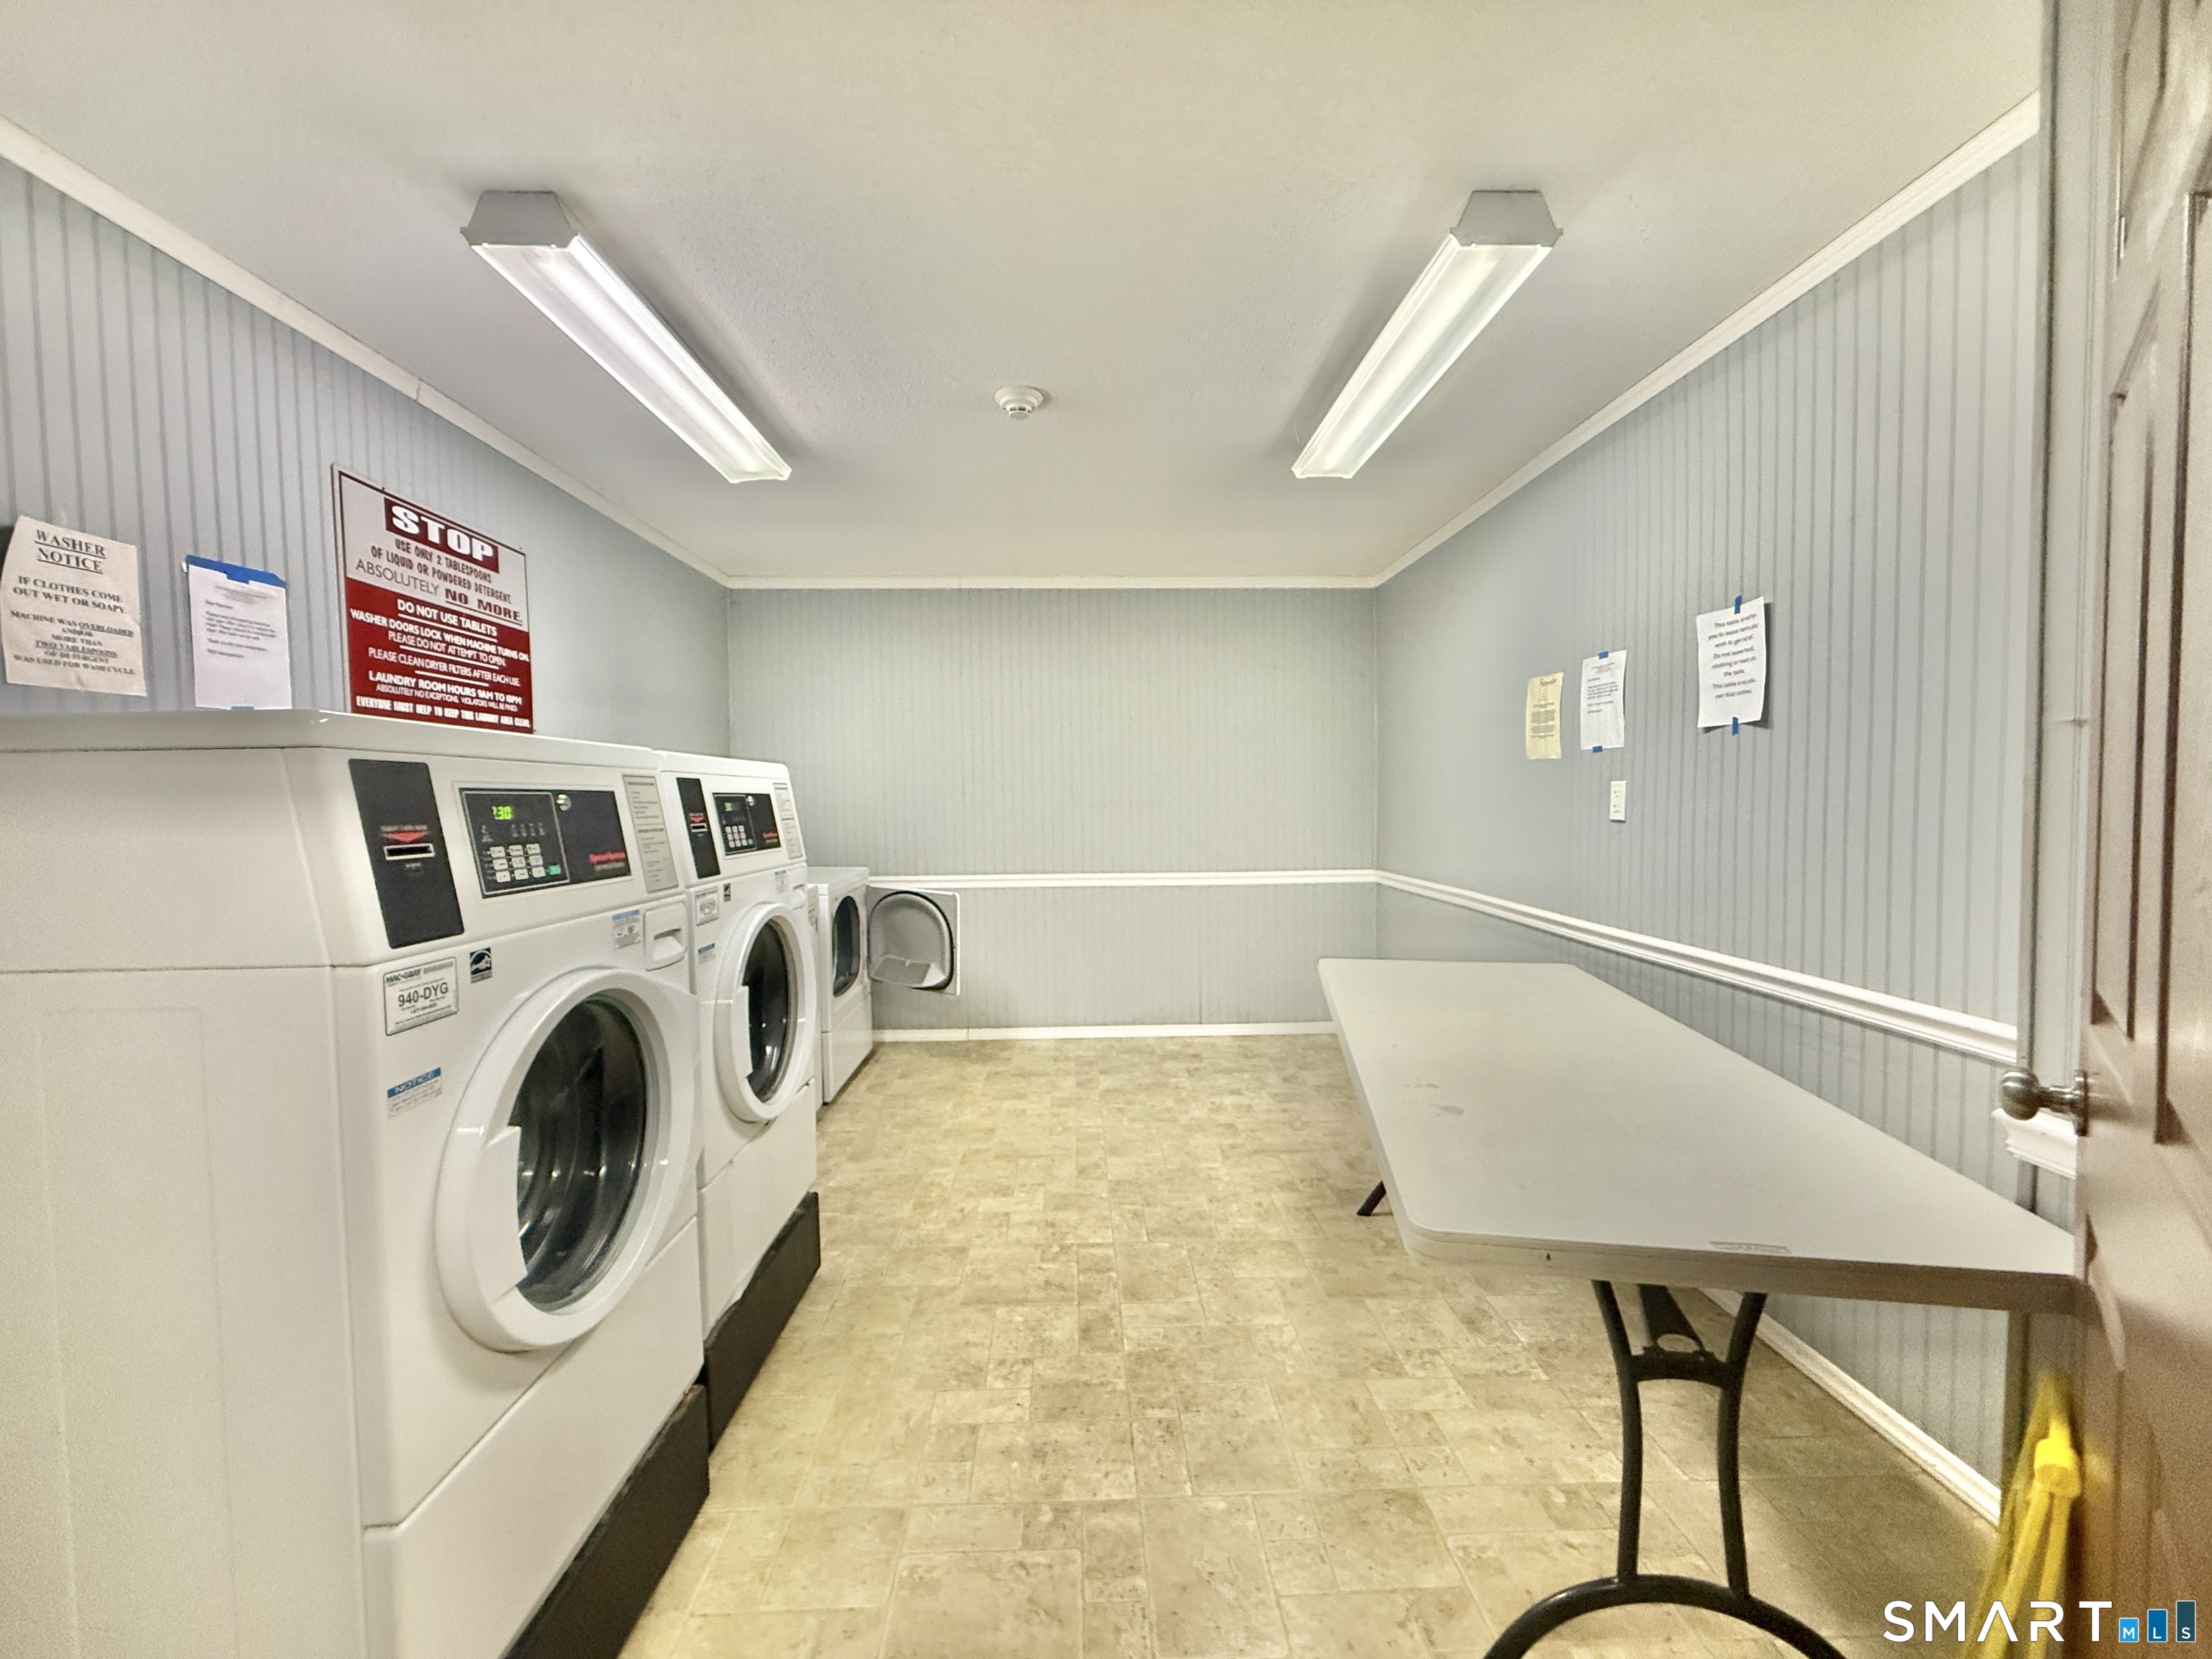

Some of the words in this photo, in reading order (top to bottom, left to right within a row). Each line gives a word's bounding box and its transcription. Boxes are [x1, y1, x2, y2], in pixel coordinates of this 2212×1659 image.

[36, 529, 106, 557] WASHER
[391, 505, 494, 562] STOP
[37, 547, 104, 572] NOTICE
[371, 545, 382, 559] OF
[386, 551, 413, 570] LIQUID
[417, 562, 429, 576] OR
[432, 567, 472, 590] POWDERED
[395, 539, 410, 552] USE
[415, 546, 433, 563] ONLY
[436, 555, 443, 565] 2
[444, 557, 492, 584] TABLESPOONS
[13, 586, 40, 598] OUT
[42, 591, 69, 604] WET
[72, 597, 89, 607] OR
[91, 601, 124, 613] SOAPY
[18, 575, 30, 584] IF
[33, 578, 89, 596] CLOTHES
[91, 590, 122, 603] COME
[356, 559, 439, 596] ABSOLUTELY
[445, 588, 468, 605] NO
[477, 598, 523, 624] MORE.
[58, 618, 77, 627] WAS
[78, 621, 134, 637] OVERLOADED
[397, 599, 414, 613] DO
[416, 603, 439, 620] NOT
[440, 611, 459, 626] USE
[460, 616, 498, 636] TABLETS
[350, 608, 388, 627] WASHER
[389, 619, 420, 636] DOORS
[421, 626, 442, 641] LOCK
[444, 632, 467, 646] WHEN
[467, 638, 497, 655] MACHINE
[498, 647, 518, 660] TURNS
[388, 631, 416, 646] PLEASE
[417, 638, 429, 649] DO
[430, 642, 446, 652] NOT
[447, 644, 477, 660] ATTEMPT
[478, 652, 488, 661] TO
[369, 647, 398, 662] PLEASE
[398, 652, 425, 667] CLEAN
[426, 658, 447, 673] DRYER
[449, 663, 472, 678] FILTERS
[472, 668, 492, 681] AFTER
[493, 673, 509, 683] EACH
[369, 670, 416, 687] LAUNDRY
[418, 678, 446, 692] ROOM
[447, 685, 477, 698] HOURS
[477, 689, 493, 701] 9AM
[494, 692, 505, 702] TO
[376, 683, 413, 696] ABSOLUTELY
[414, 689, 424, 698] NO
[356, 696, 392, 711] EVERYONE
[393, 701, 414, 713] MUST
[415, 704, 432, 715] HELP
[433, 706, 443, 717] TO
[444, 708, 459, 719] KEEP
[398, 981, 449, 1007] 940-DYG
